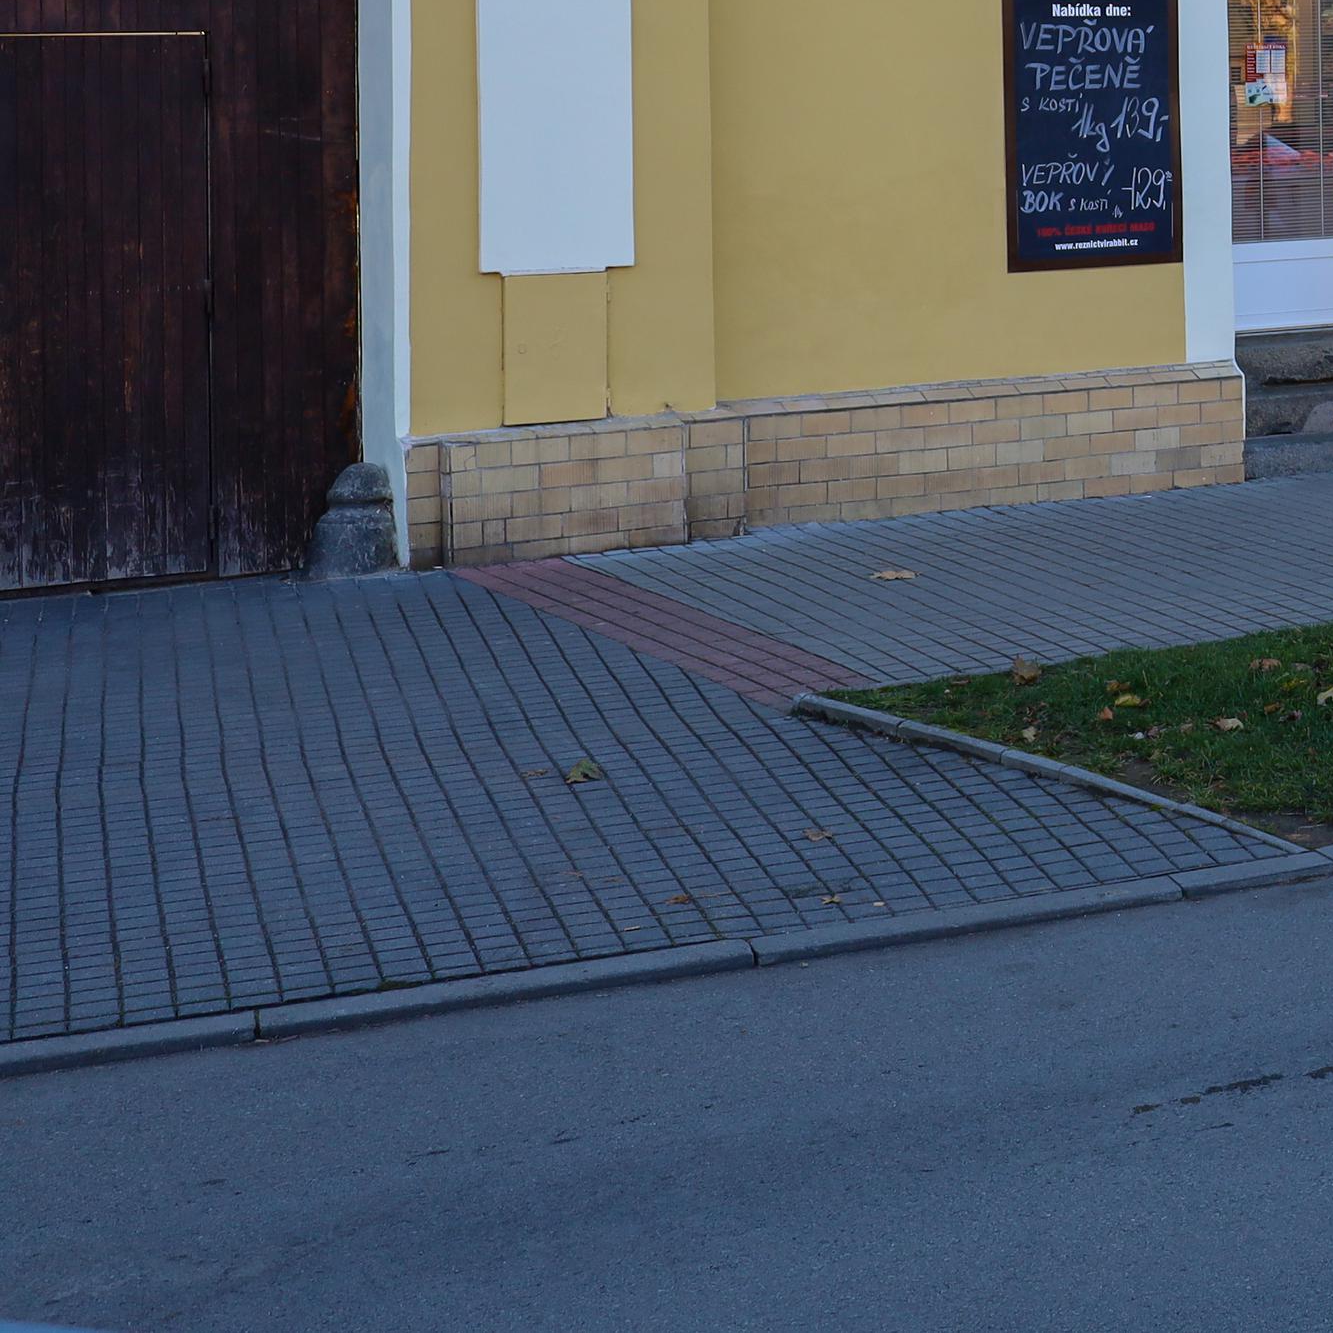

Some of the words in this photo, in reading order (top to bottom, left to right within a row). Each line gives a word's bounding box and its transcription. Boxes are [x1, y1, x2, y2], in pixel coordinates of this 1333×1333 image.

[1052, 3, 1101, 17] Nabídka
[1105, 4, 1131, 17] dne:
[1020, 18, 1155, 54] VEPŘOVÁ
[1024, 56, 1143, 91] PEČENĚ
[1020, 189, 1065, 213] BOK
[1055, 238, 1139, 251] www.reznictvirabbit.cz
